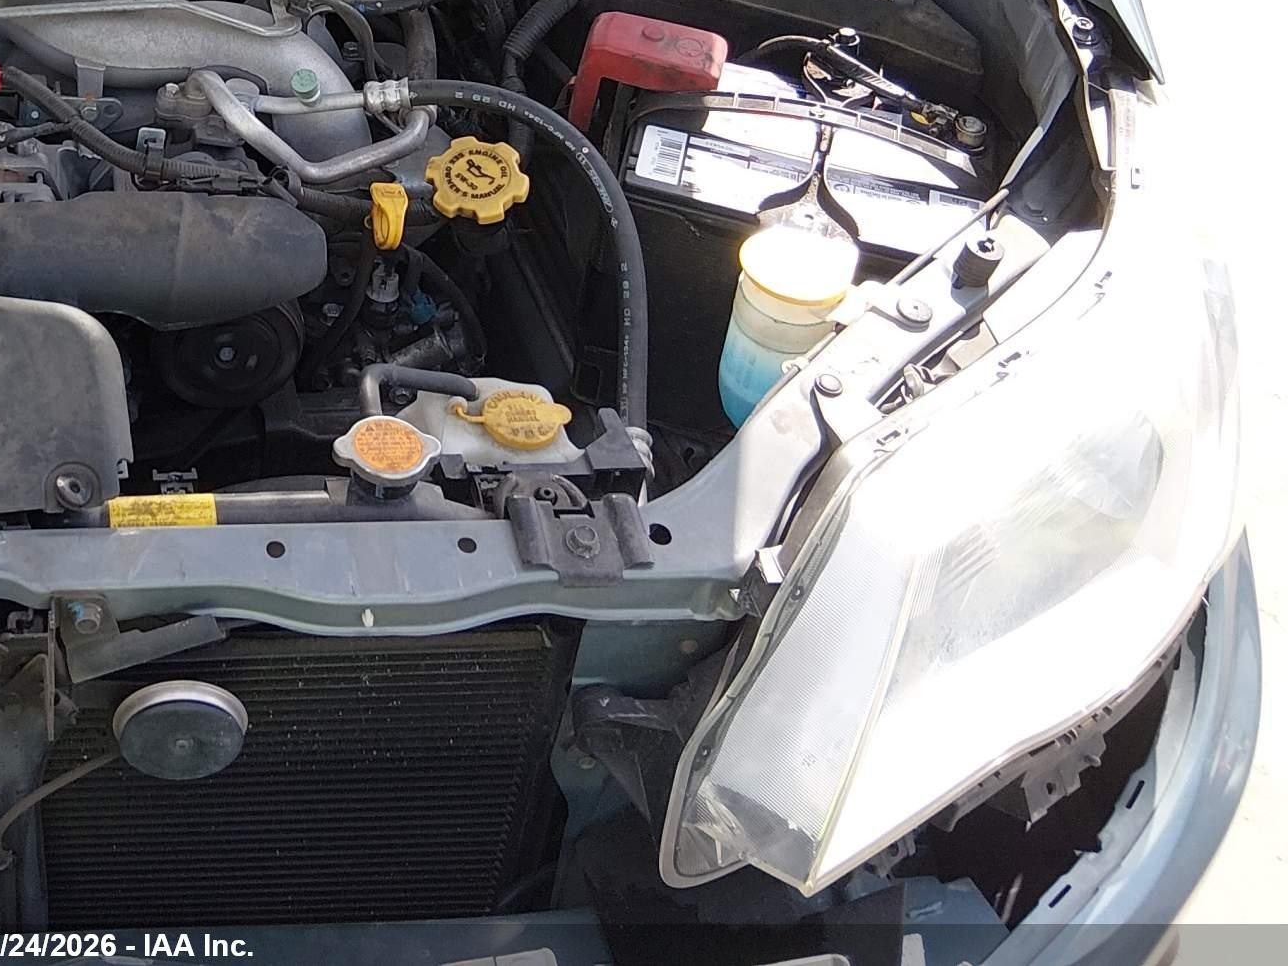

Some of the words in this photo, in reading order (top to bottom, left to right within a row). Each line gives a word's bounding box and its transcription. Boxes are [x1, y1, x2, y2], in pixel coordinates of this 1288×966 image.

[498, 100, 516, 112] HD
[468, 149, 503, 166] ENGINE
[499, 165, 509, 179] OIL
[448, 152, 465, 166] SEE
[471, 183, 506, 200] MANUAL
[455, 172, 479, 191] 5W-30
[623, 308, 631, 326] HD
